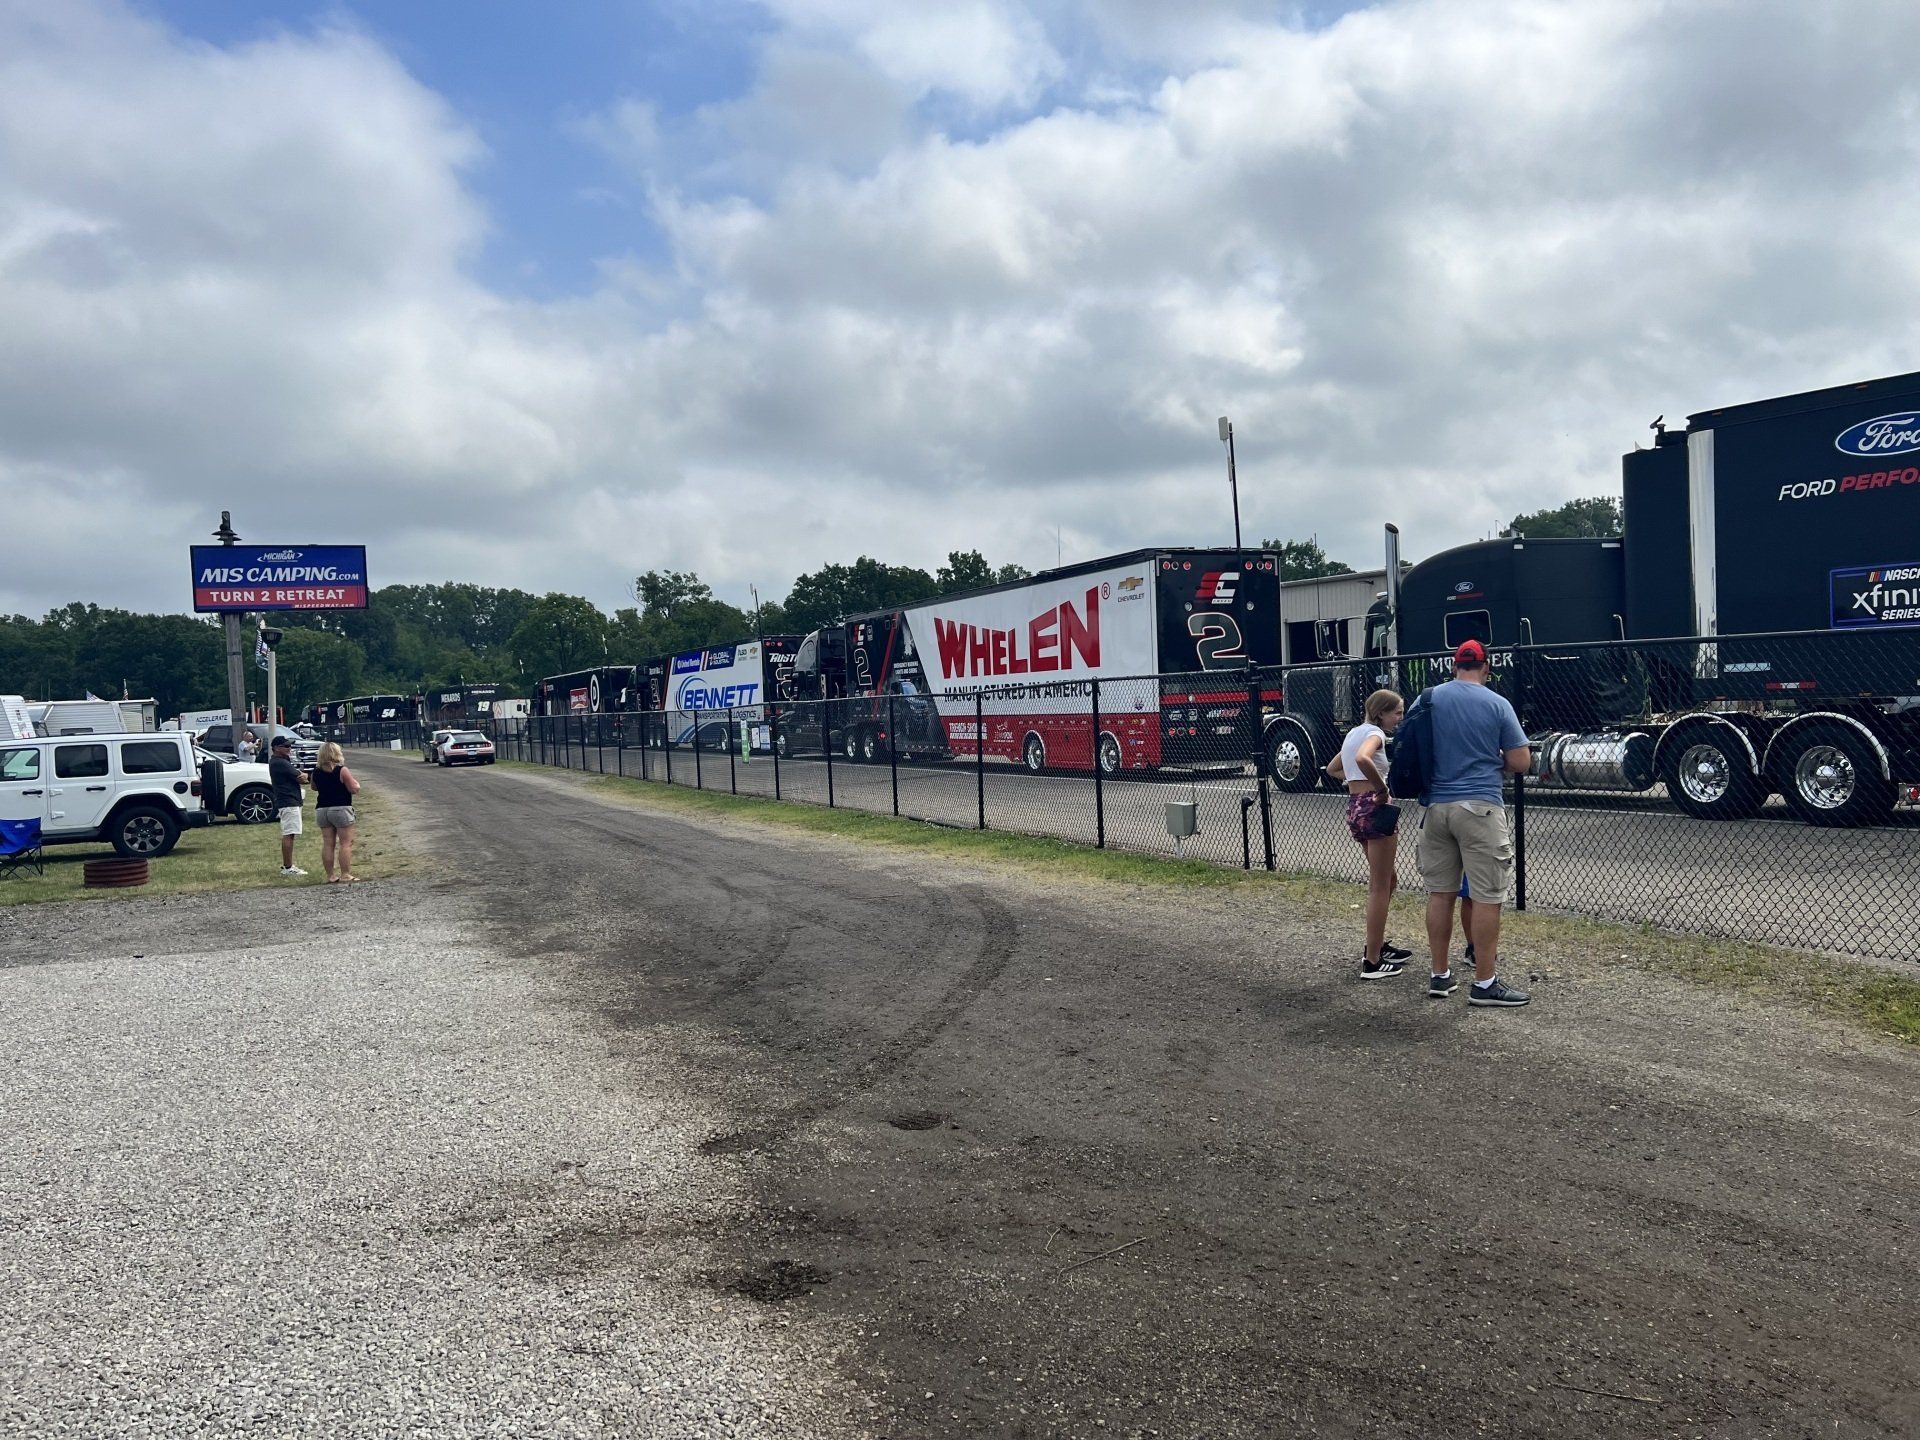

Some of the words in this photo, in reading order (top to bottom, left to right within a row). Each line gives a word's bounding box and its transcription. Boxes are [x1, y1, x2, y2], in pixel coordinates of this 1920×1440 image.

[1779, 479, 1836, 501] FORD
[1840, 467, 1920, 492] PERFO
[263, 552, 296, 560] MICHIGAN
[200, 568, 244, 583] MIS
[210, 591, 254, 602] TURN
[261, 590, 270, 601] 2
[276, 590, 345, 601] RETREAT
[1118, 593, 1145, 602] CHEVROLET
[1852, 584, 1920, 615] xfini
[934, 586, 1101, 679] WHELEN
[1187, 612, 1249, 671] 2
[854, 648, 872, 685] 2
[684, 684, 758, 709] BENNETT
[944, 682, 1024, 702] MANUFACTURED
[381, 709, 395, 718] 54
[478, 701, 490, 711] 19
